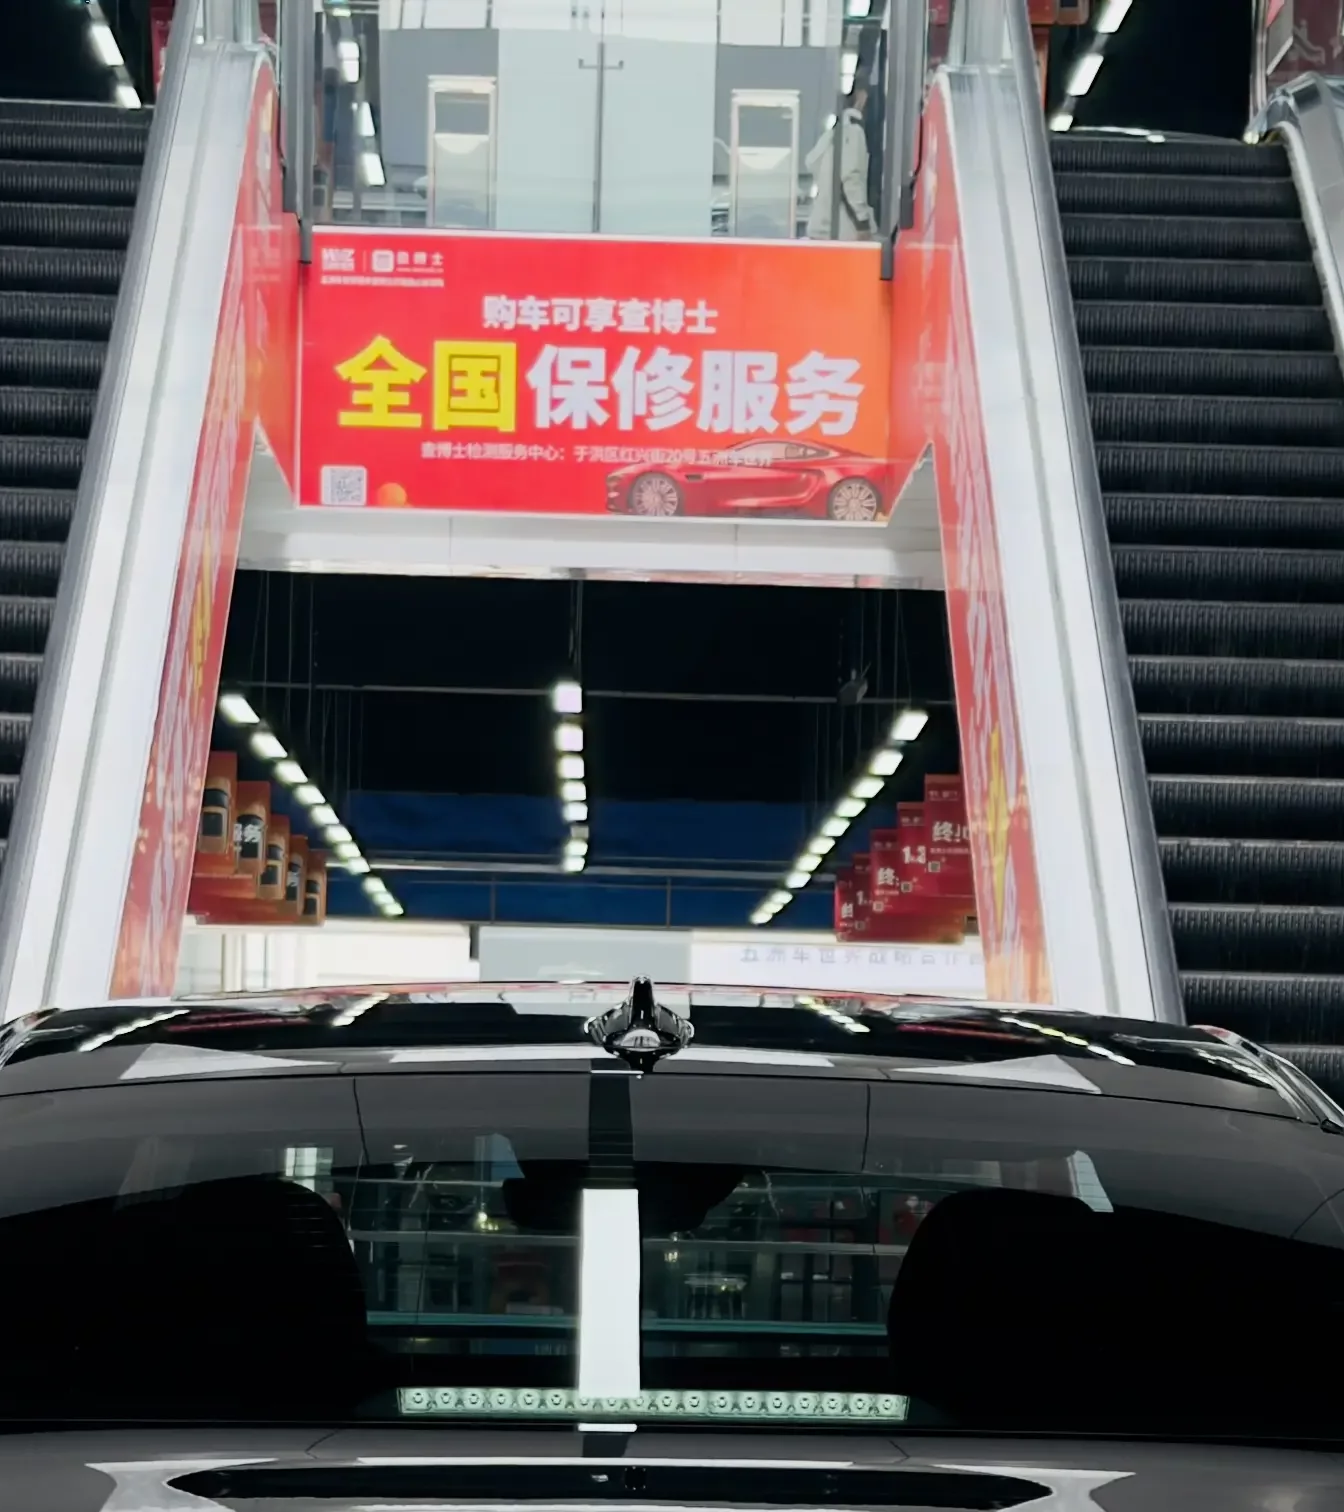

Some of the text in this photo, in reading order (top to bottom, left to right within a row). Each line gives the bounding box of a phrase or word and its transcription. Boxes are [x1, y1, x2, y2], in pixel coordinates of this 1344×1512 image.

[483, 295, 718, 334] 购车可享查博士
[334, 334, 865, 436] 全国保修服务
